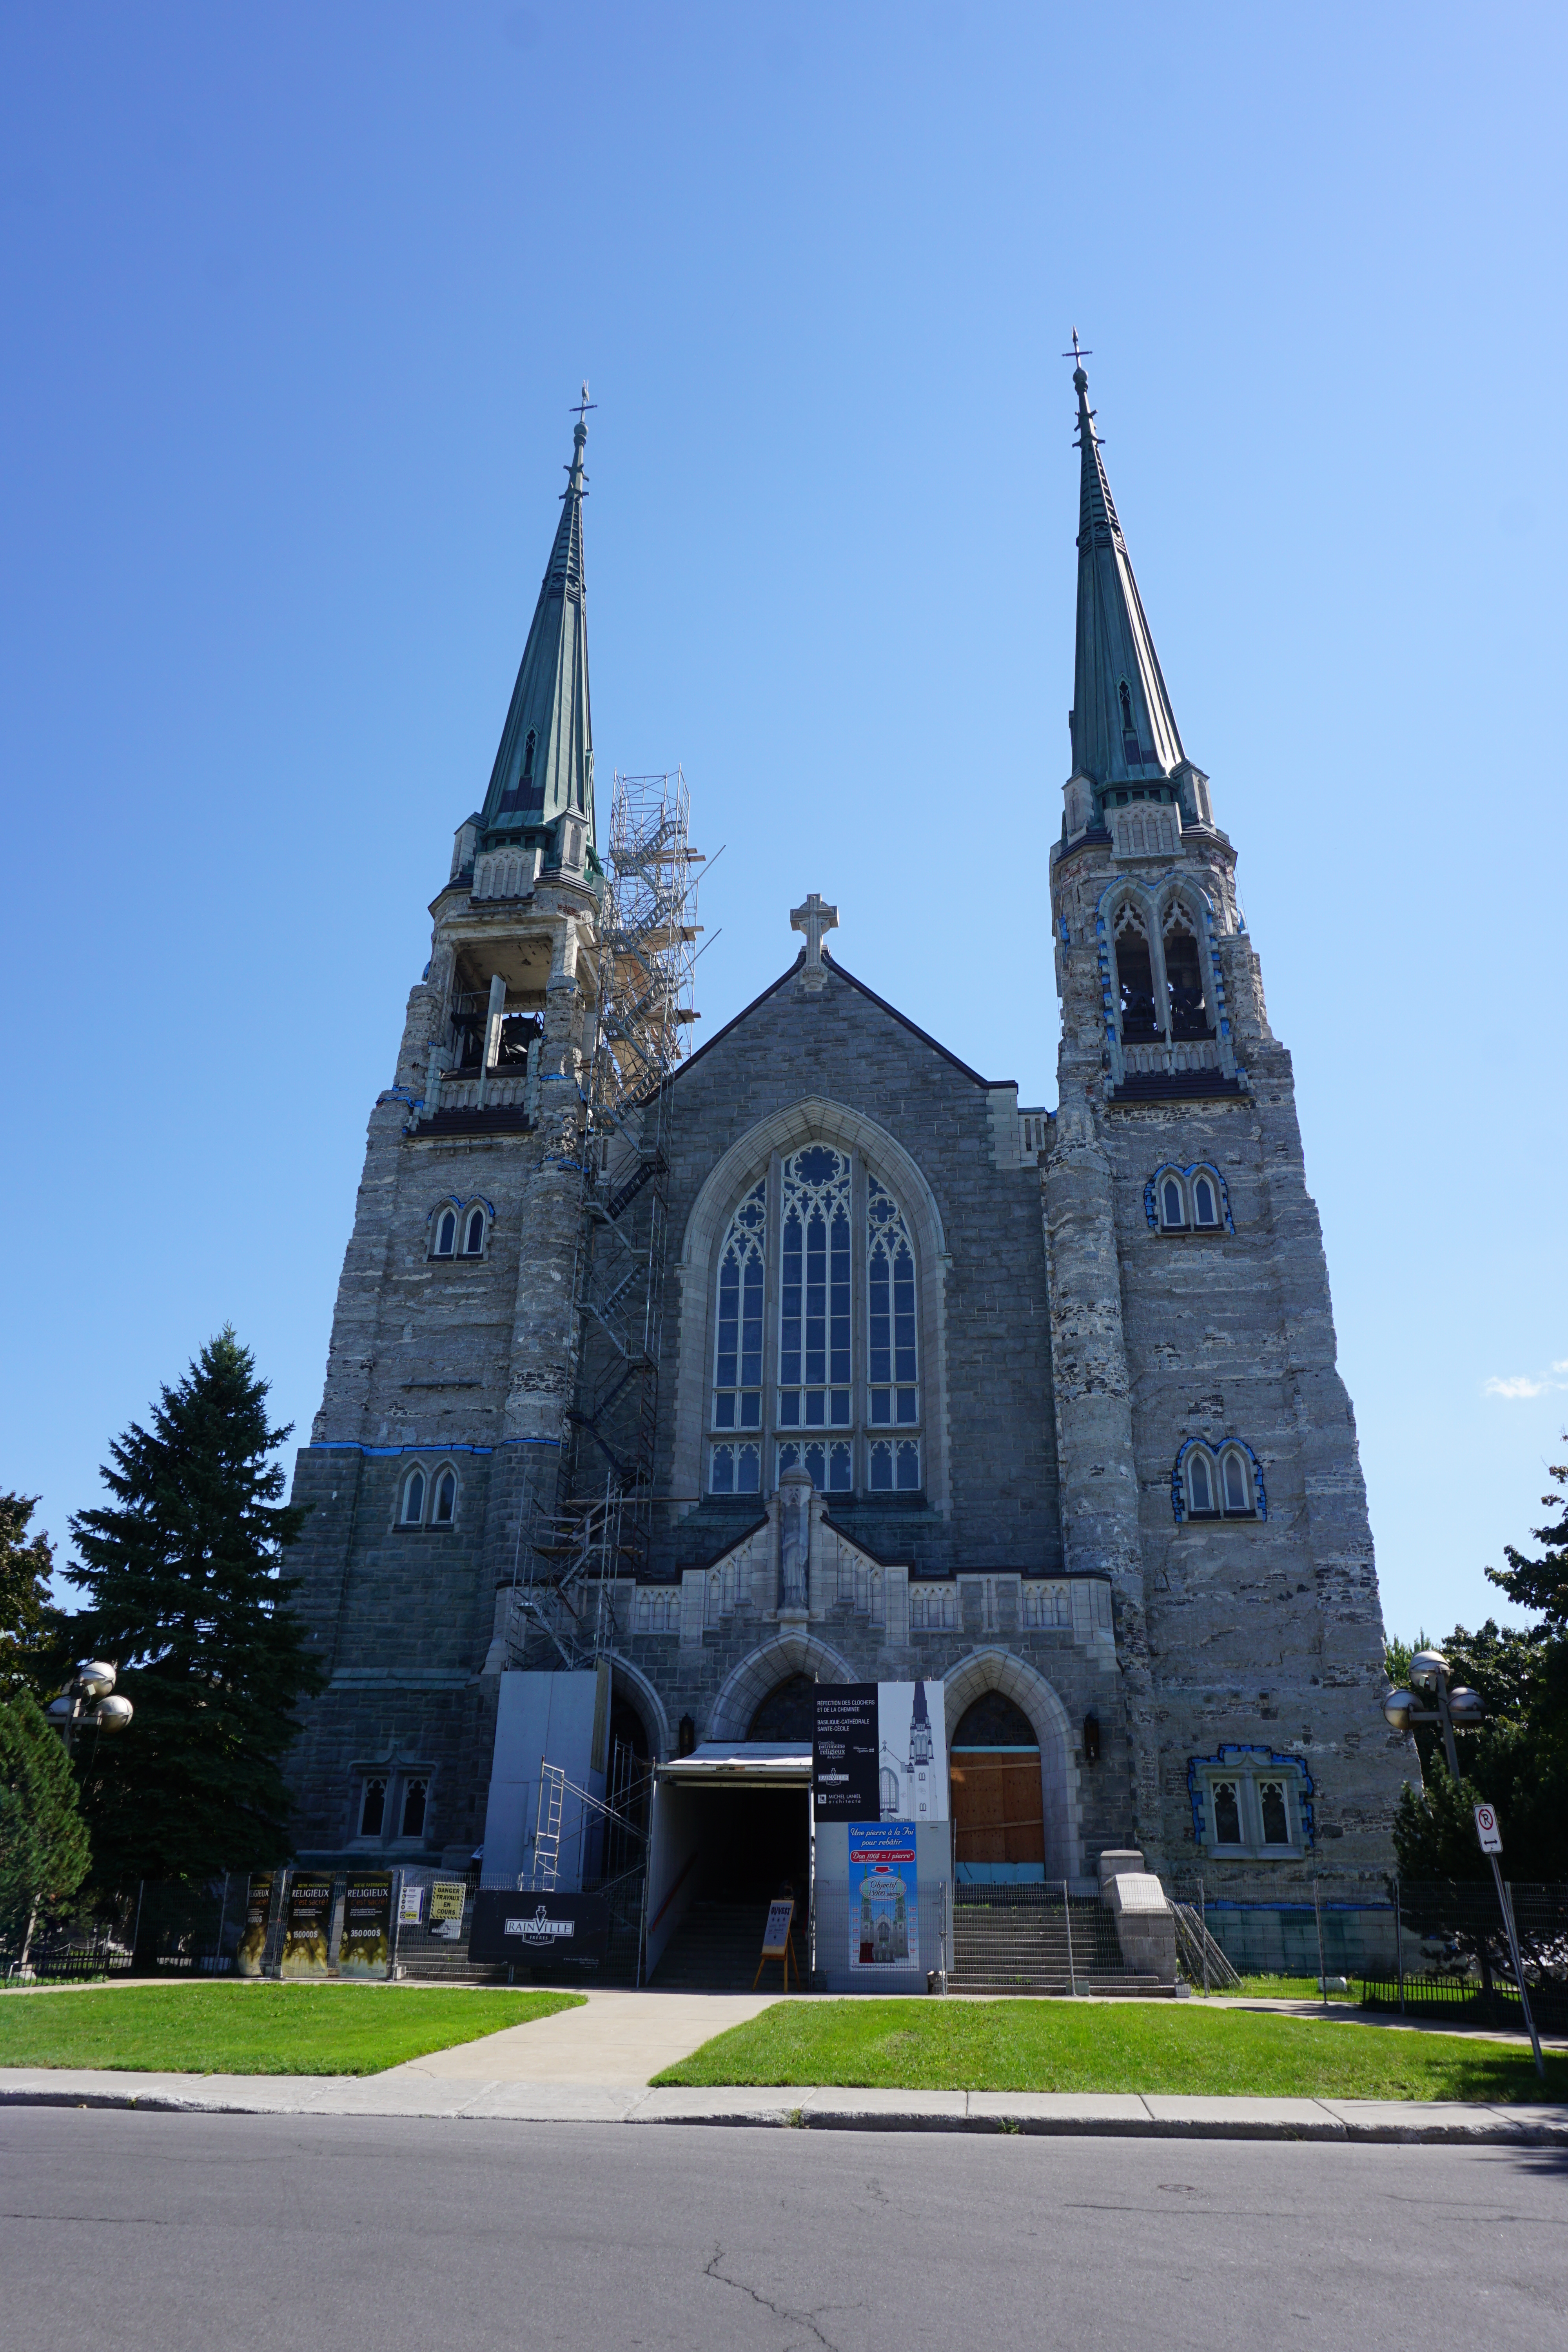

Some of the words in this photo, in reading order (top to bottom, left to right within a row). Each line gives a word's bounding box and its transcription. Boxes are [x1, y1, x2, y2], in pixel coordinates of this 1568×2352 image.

[850, 1828, 864, 1836] Une
[865, 1829, 886, 1838] pierre
[894, 1827, 900, 1835] la
[902, 1827, 914, 1835] Foi
[878, 1837, 902, 1845] rebâtir
[870, 1880, 898, 1890] Objectif
[292, 1889, 330, 1897] RELIGIEUX
[347, 1889, 388, 1897] RELIGIEUX
[771, 1907, 791, 1915] OUVERT
[508, 1920, 571, 1933] RAINVILLE
